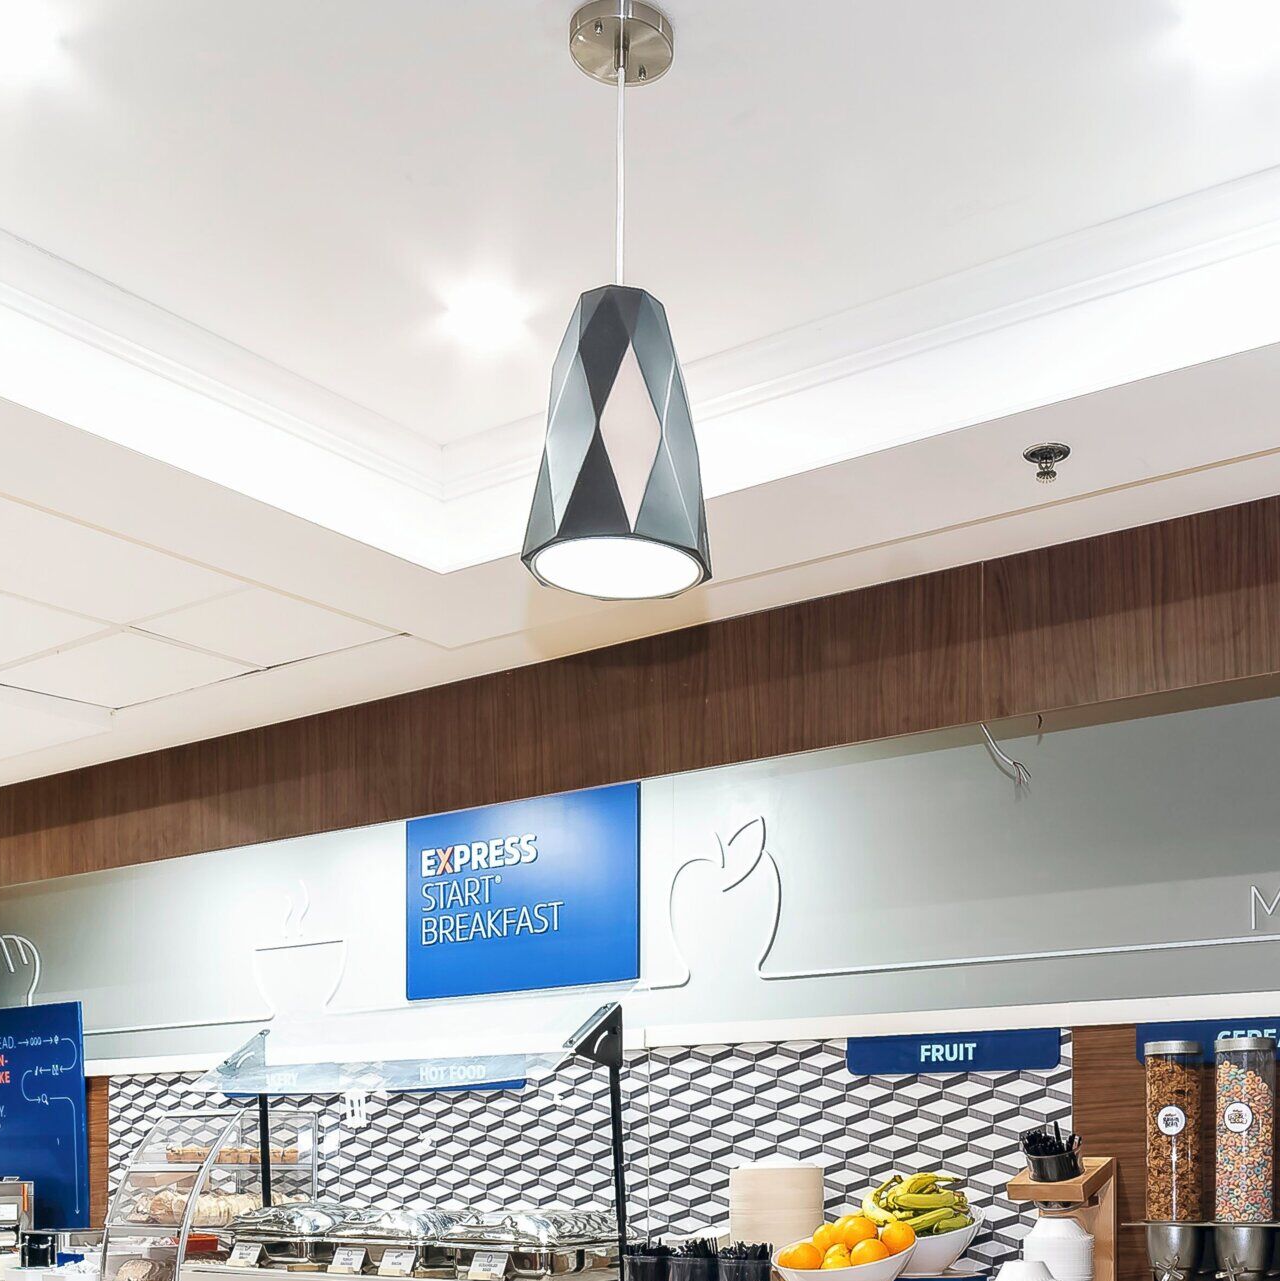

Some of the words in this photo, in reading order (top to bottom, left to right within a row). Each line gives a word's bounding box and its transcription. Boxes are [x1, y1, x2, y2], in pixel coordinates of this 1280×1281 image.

[421, 834, 539, 878] EXPRESS
[421, 901, 564, 946] BREAKFAST
[920, 1042, 977, 1062] FRUIT
[419, 1066, 446, 1082] HOT
[449, 1064, 486, 1081] FOOD
